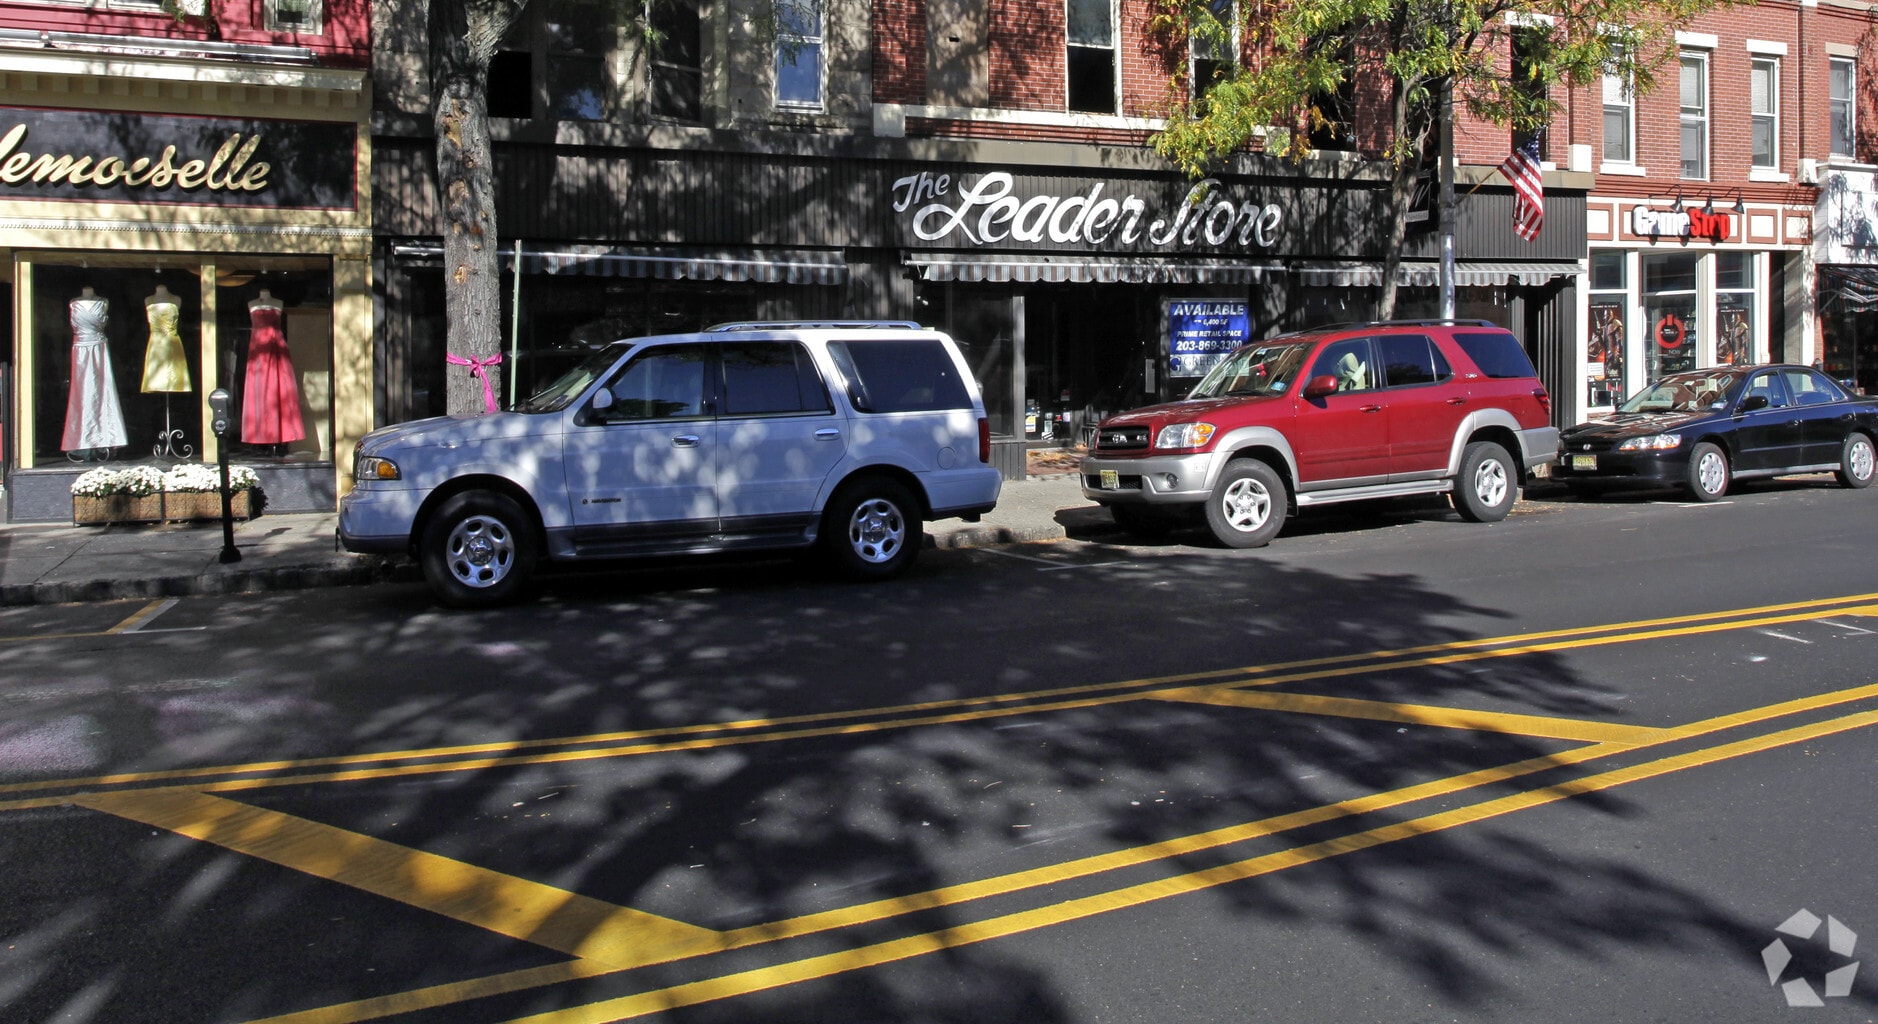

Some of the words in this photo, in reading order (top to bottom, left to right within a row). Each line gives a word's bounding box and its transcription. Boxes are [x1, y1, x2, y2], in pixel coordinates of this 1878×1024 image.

[891, 171, 950, 213] The
[912, 171, 1146, 246] Leader
[1149, 177, 1282, 248] Store
[1632, 205, 1731, 241] GameStop
[1174, 304, 1244, 316] AVAILABLE
[1176, 340, 1243, 351] 203-869-3300
